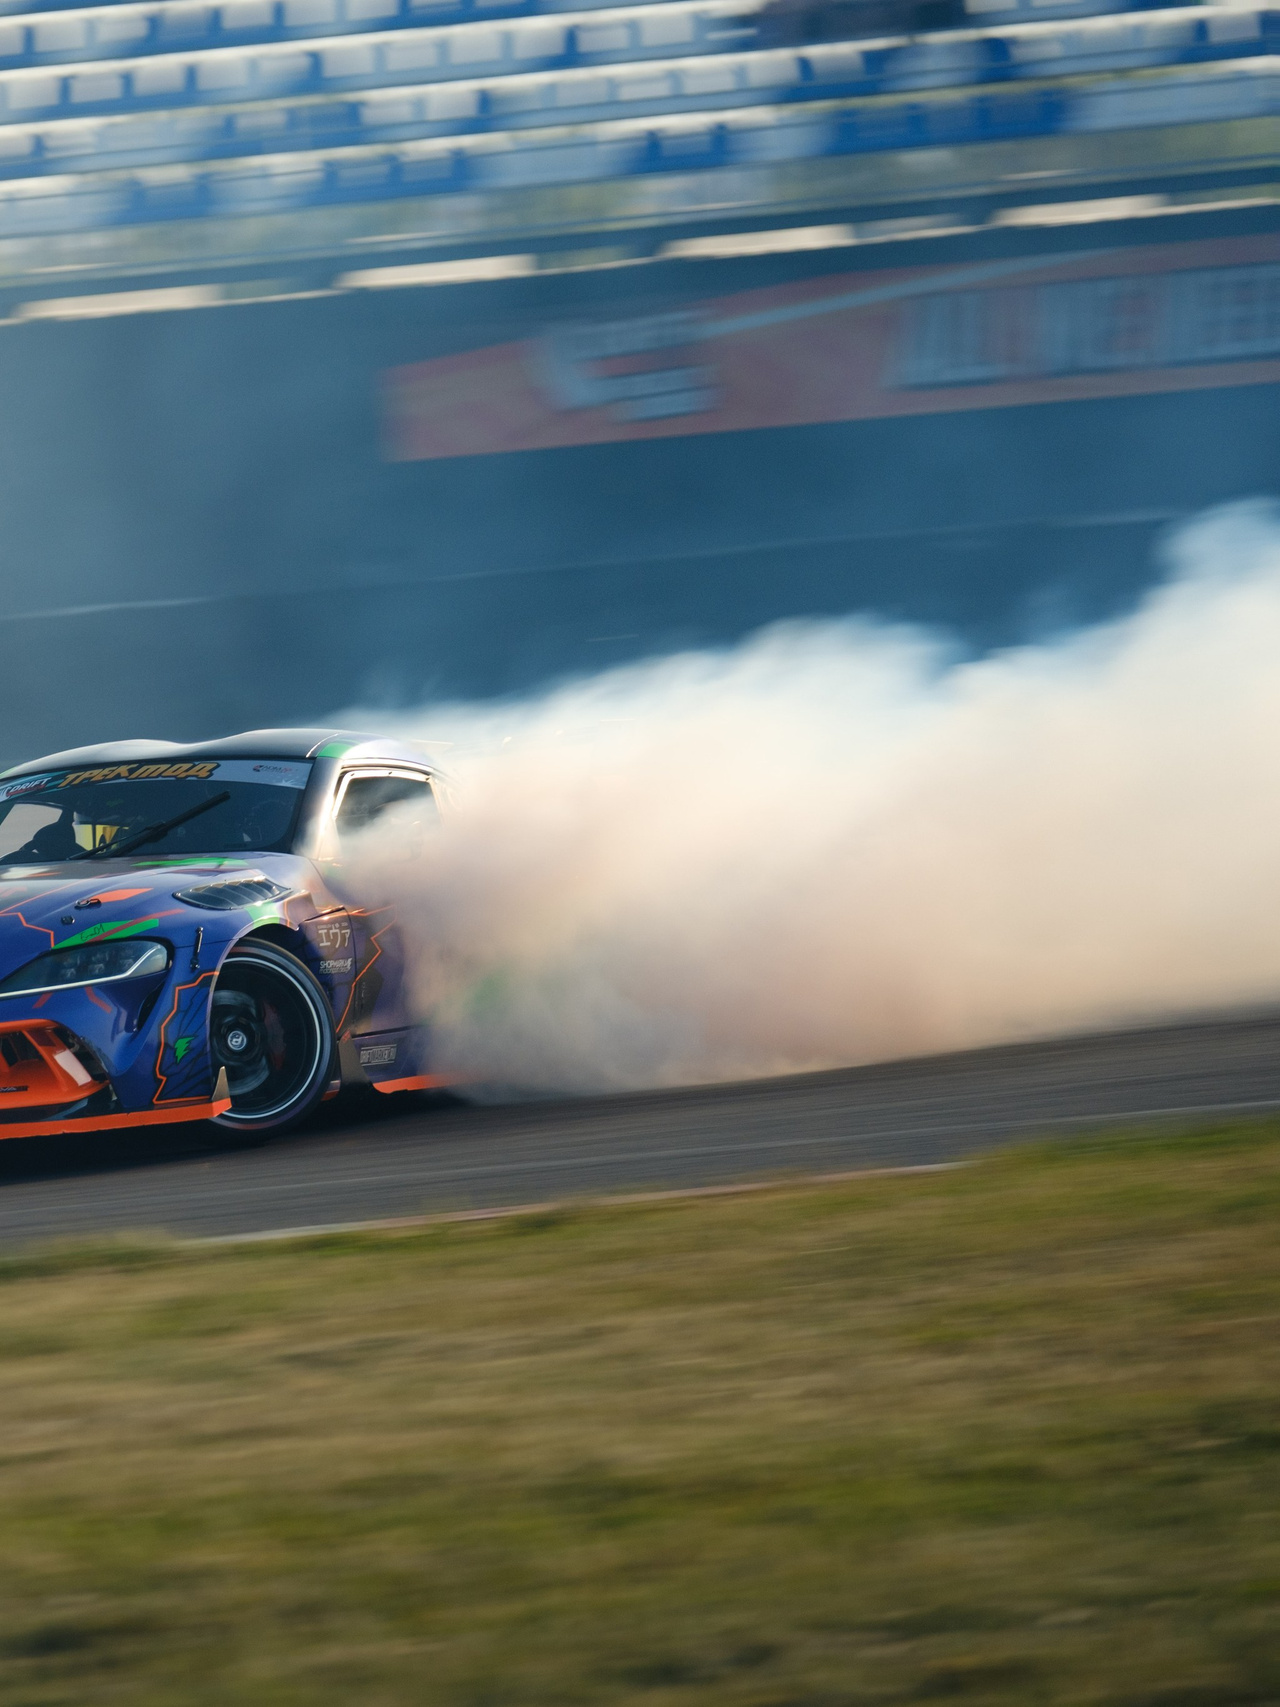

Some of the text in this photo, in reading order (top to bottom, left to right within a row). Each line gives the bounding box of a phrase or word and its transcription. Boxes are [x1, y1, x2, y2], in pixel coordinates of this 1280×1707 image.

[10, 777, 52, 793] DRIFT
[318, 924, 351, 948] エヴァ
